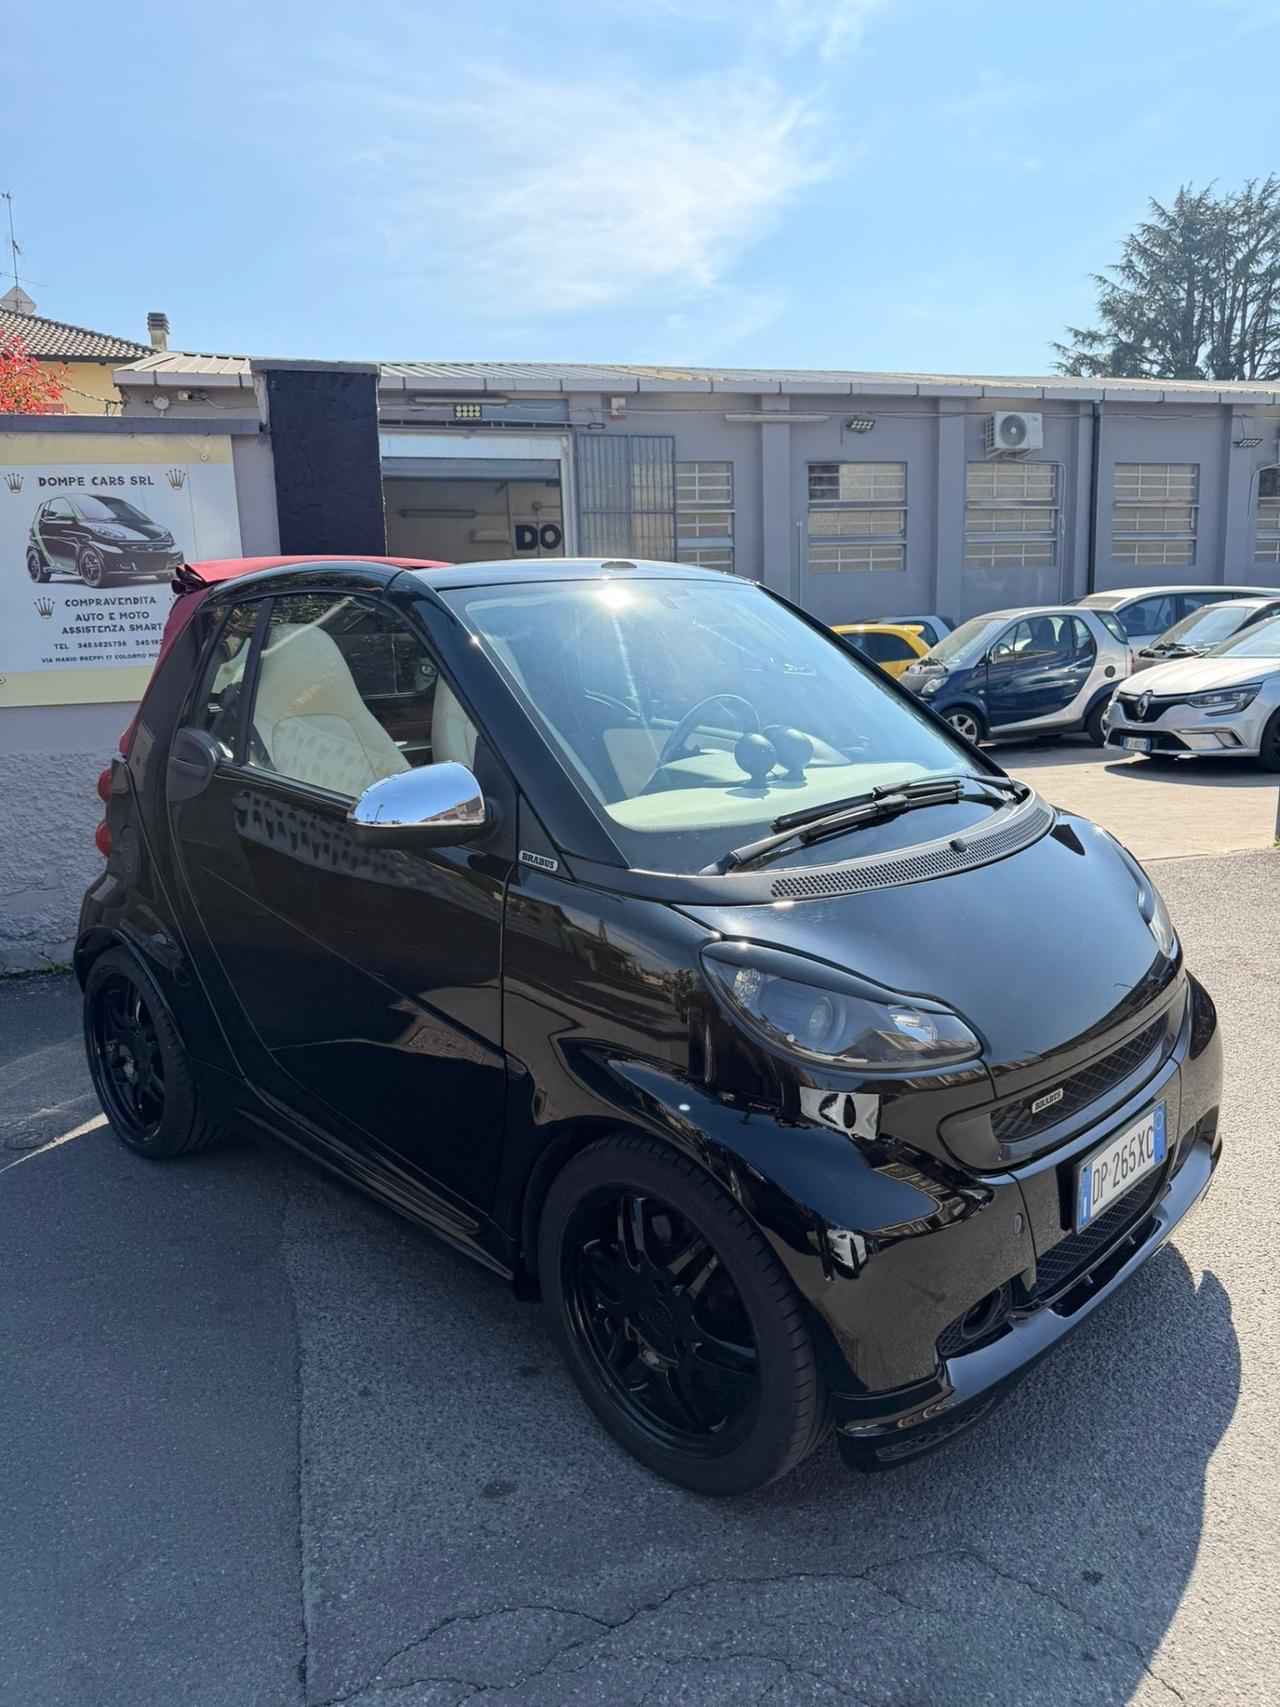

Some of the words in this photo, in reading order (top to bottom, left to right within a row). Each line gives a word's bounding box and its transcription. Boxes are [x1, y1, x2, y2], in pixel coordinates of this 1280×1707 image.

[38, 476, 85, 487] DOMPE
[91, 476, 125, 486] CARS
[130, 475, 155, 486] SRL
[515, 523, 561, 550] DO
[65, 596, 157, 608] COMPRAVENDITA
[75, 612, 104, 622] AUTO
[109, 612, 116, 621] E
[119, 611, 150, 620] MOTO
[62, 624, 125, 635] ASSISTENZA
[129, 622, 163, 632] SMART
[521, 851, 555, 869] BRABUS
[1092, 1161, 1108, 1205] DP
[1112, 1125, 1154, 1188] 265XC
